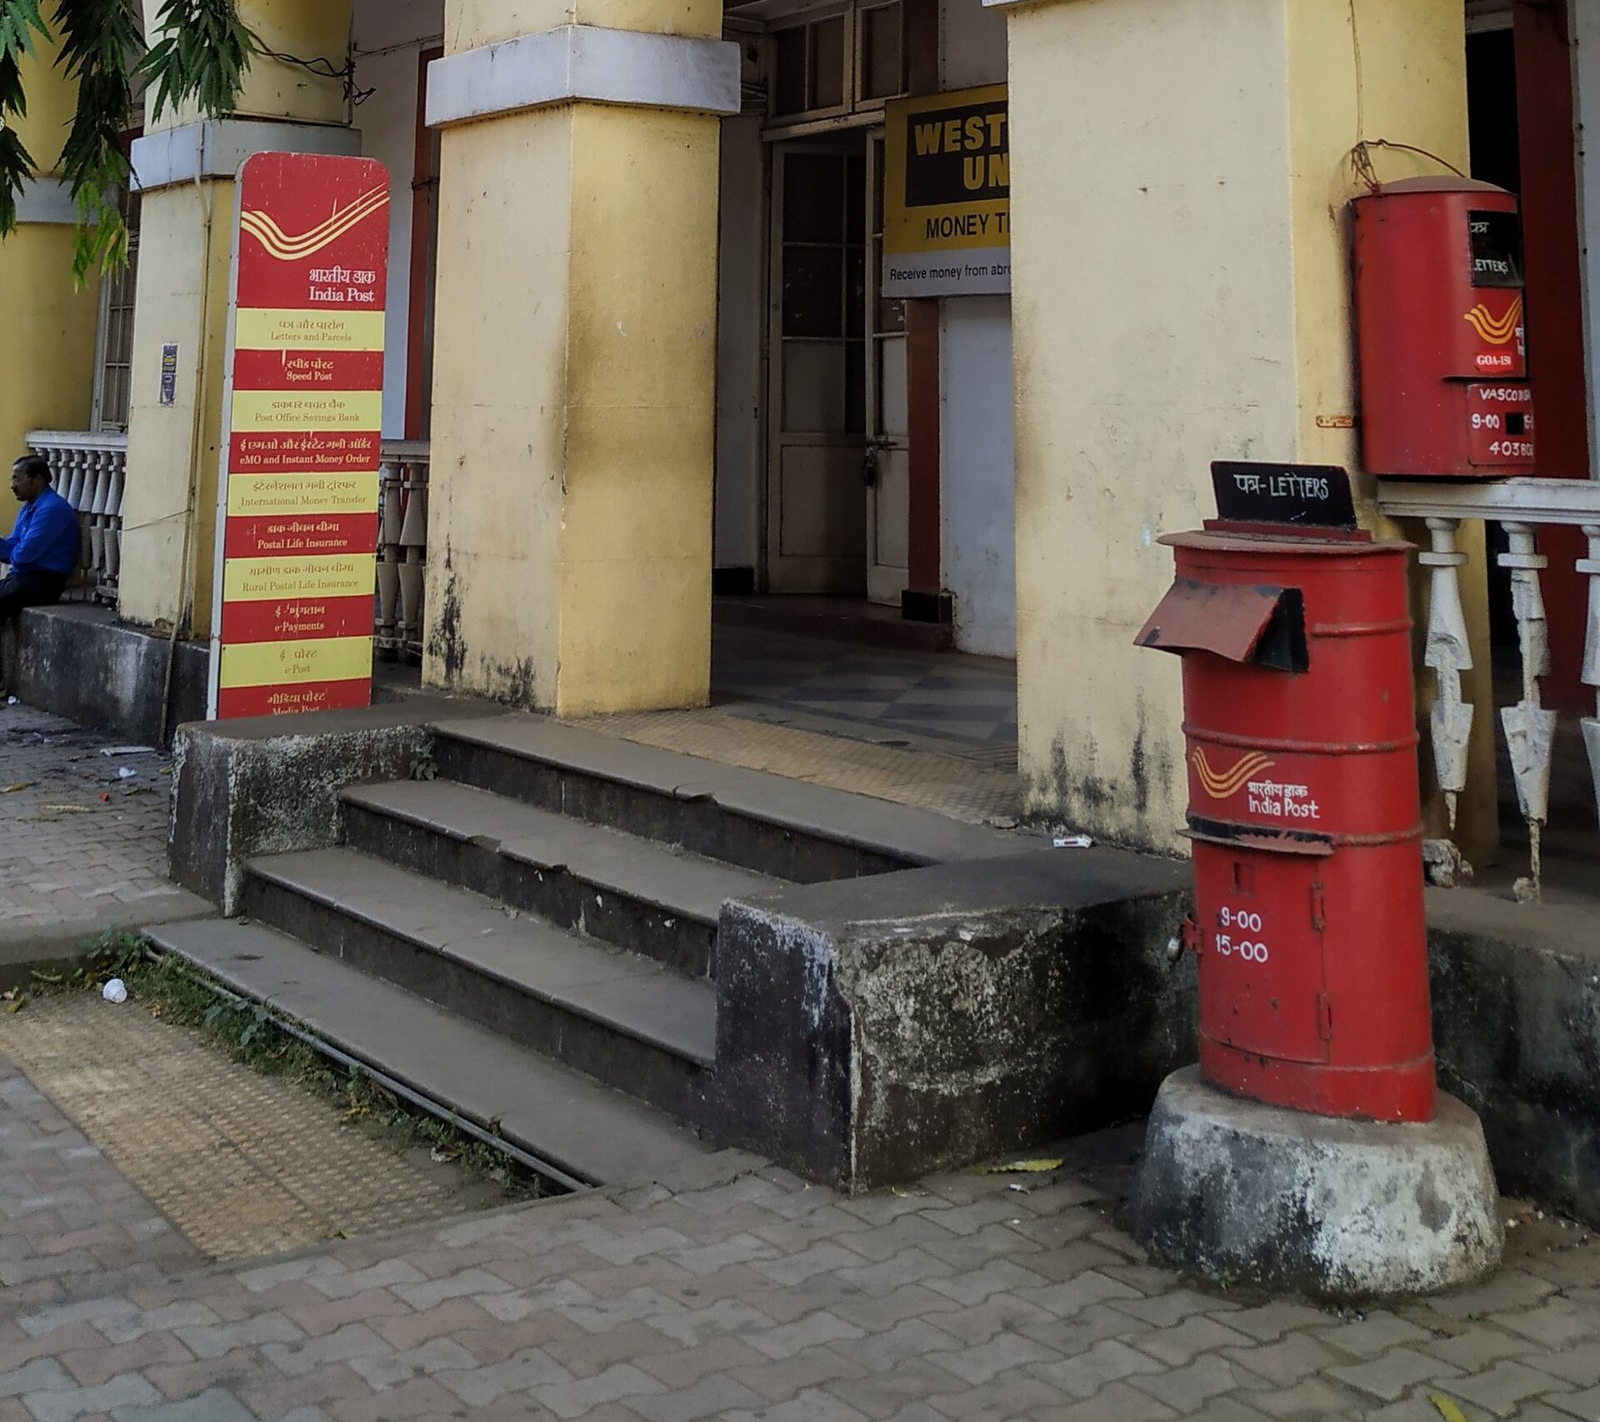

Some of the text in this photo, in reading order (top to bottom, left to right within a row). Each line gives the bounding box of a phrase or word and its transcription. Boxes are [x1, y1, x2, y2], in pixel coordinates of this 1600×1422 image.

[914, 113, 1007, 156] WEST
[963, 153, 1010, 190] UN
[926, 212, 990, 240] MONEY
[309, 265, 376, 284] भारतीय डाक
[890, 263, 1012, 281] Receive money from abro
[309, 286, 375, 302] India Post
[271, 331, 352, 342] Letters and Parcels
[286, 371, 333, 382] Speed Post
[254, 412, 360, 423] Post Office Savings Bank
[1471, 412, 1500, 429] 9-00
[240, 453, 371, 465] eMO and Instant Money Order
[1269, 475, 1330, 500] LETTERS
[241, 495, 367, 507] International Money Transfer
[257, 538, 348, 550] Postal Life Insurance
[242, 579, 359, 592] Rural Postal Life Insurance
[274, 621, 325, 633] e-Payments
[1248, 779, 1308, 798] भारतीय डाक
[1248, 795, 1320, 819] India Post
[1219, 906, 1262, 932] 9-00
[1215, 933, 1269, 963] 15-00
